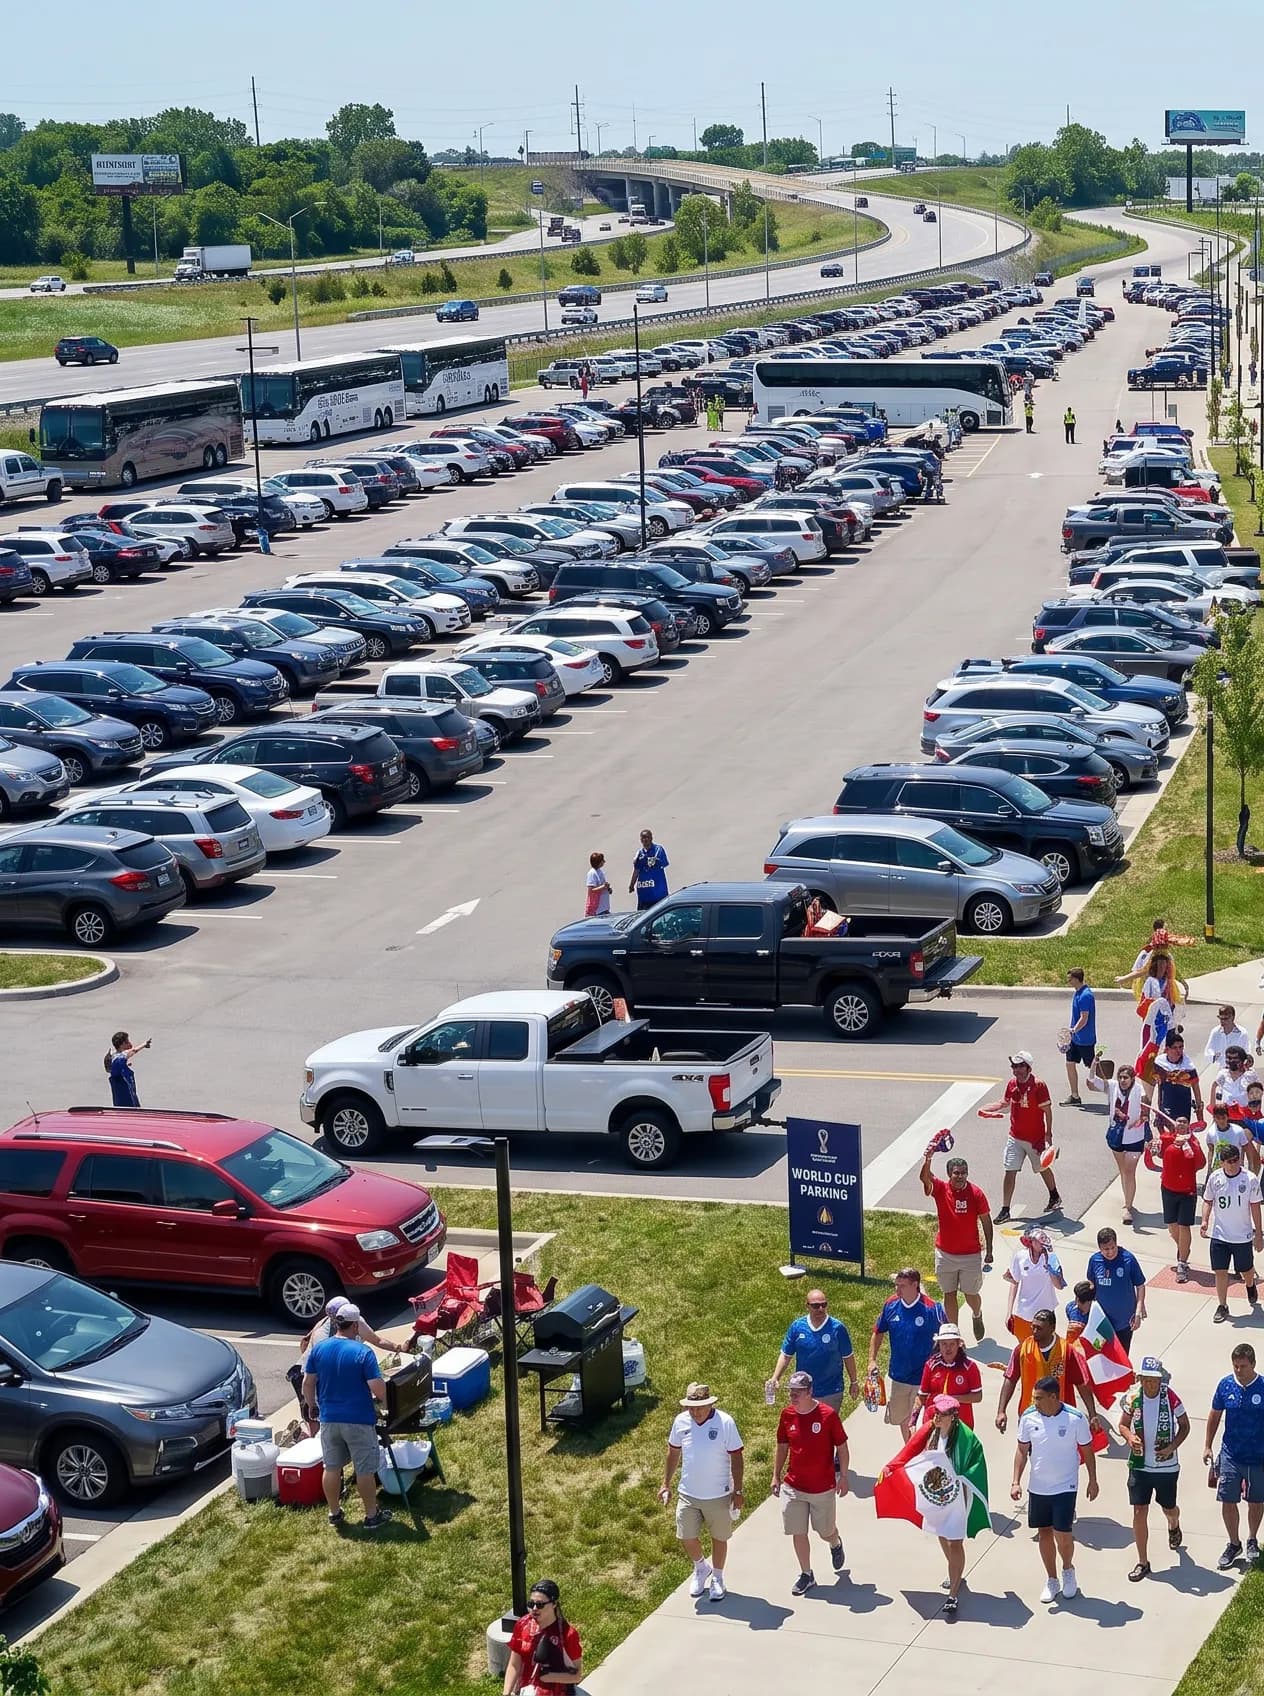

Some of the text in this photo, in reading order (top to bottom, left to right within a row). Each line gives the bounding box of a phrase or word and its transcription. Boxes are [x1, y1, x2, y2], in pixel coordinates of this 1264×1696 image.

[792, 1167, 857, 1186] WORLD CUP
[800, 1184, 848, 1201] PARKING
